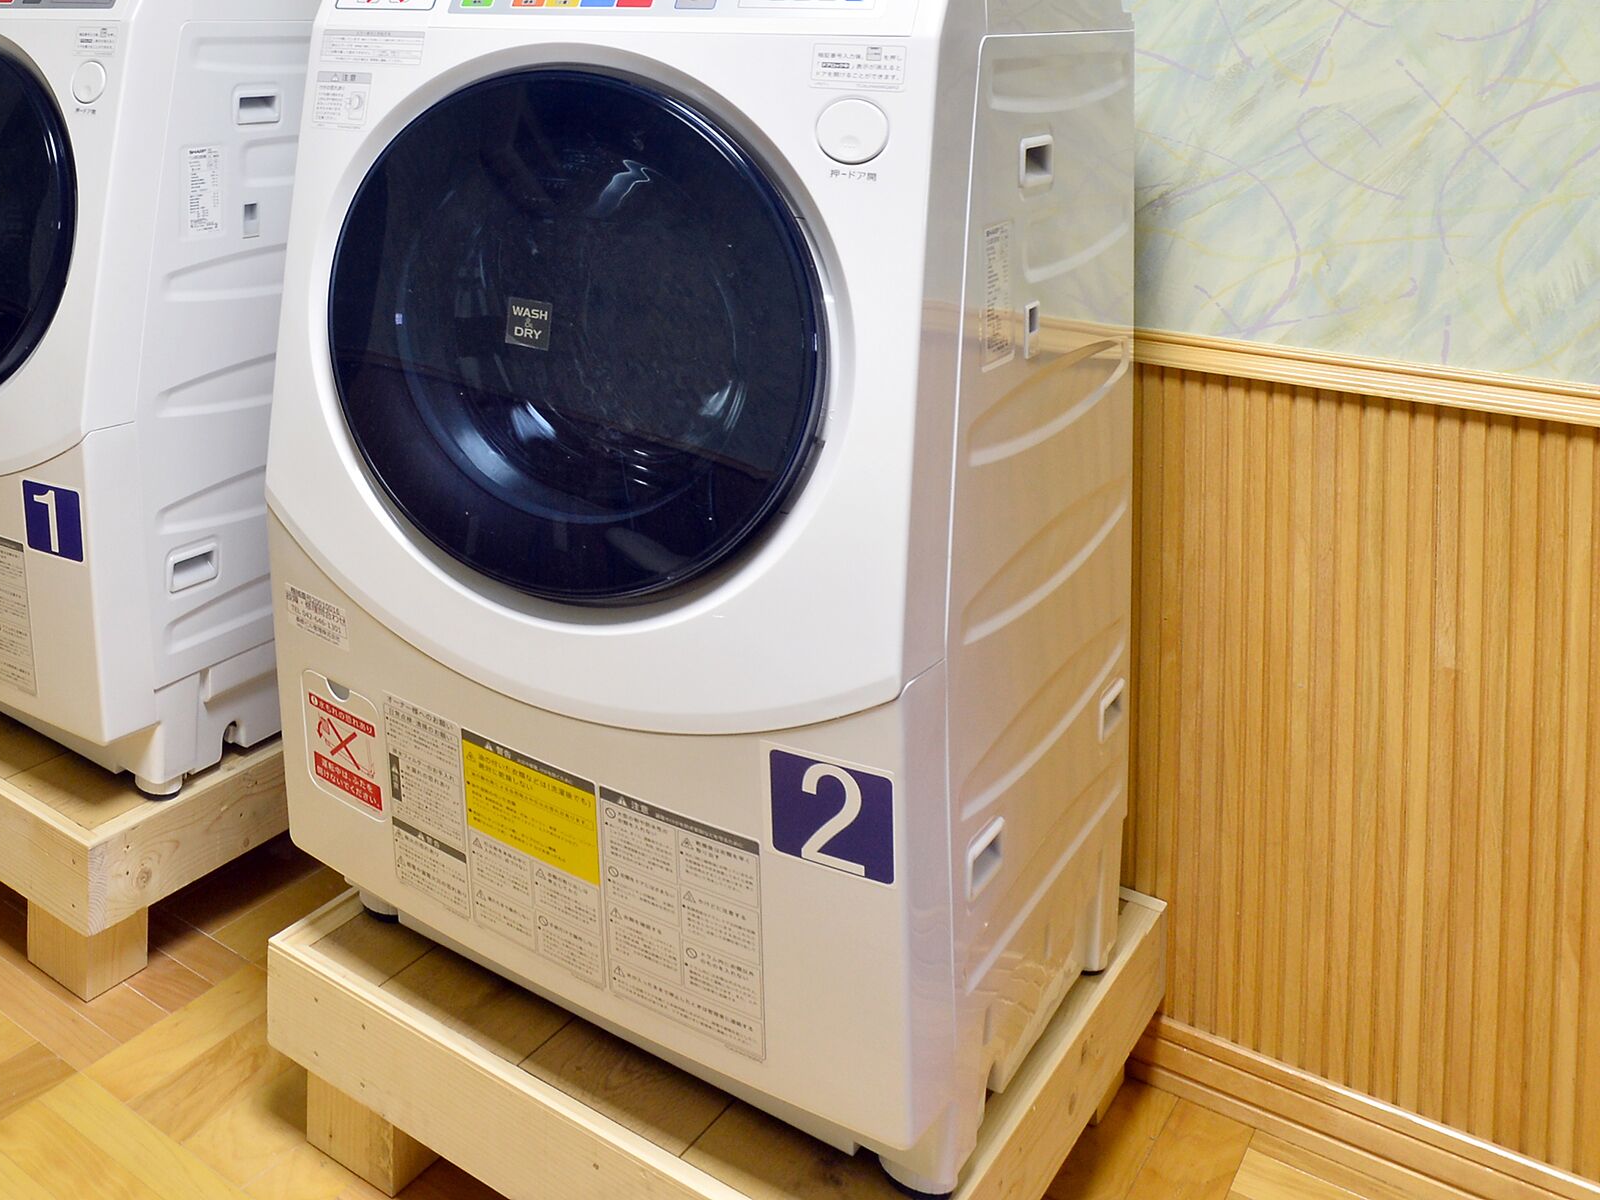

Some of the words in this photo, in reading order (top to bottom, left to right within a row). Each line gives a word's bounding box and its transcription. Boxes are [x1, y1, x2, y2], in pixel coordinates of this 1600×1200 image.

[512, 305, 548, 320] WASH
[513, 326, 542, 340] DRY
[33, 490, 60, 553] 1
[630, 800, 649, 815] 注意
[801, 763, 865, 876] 2
